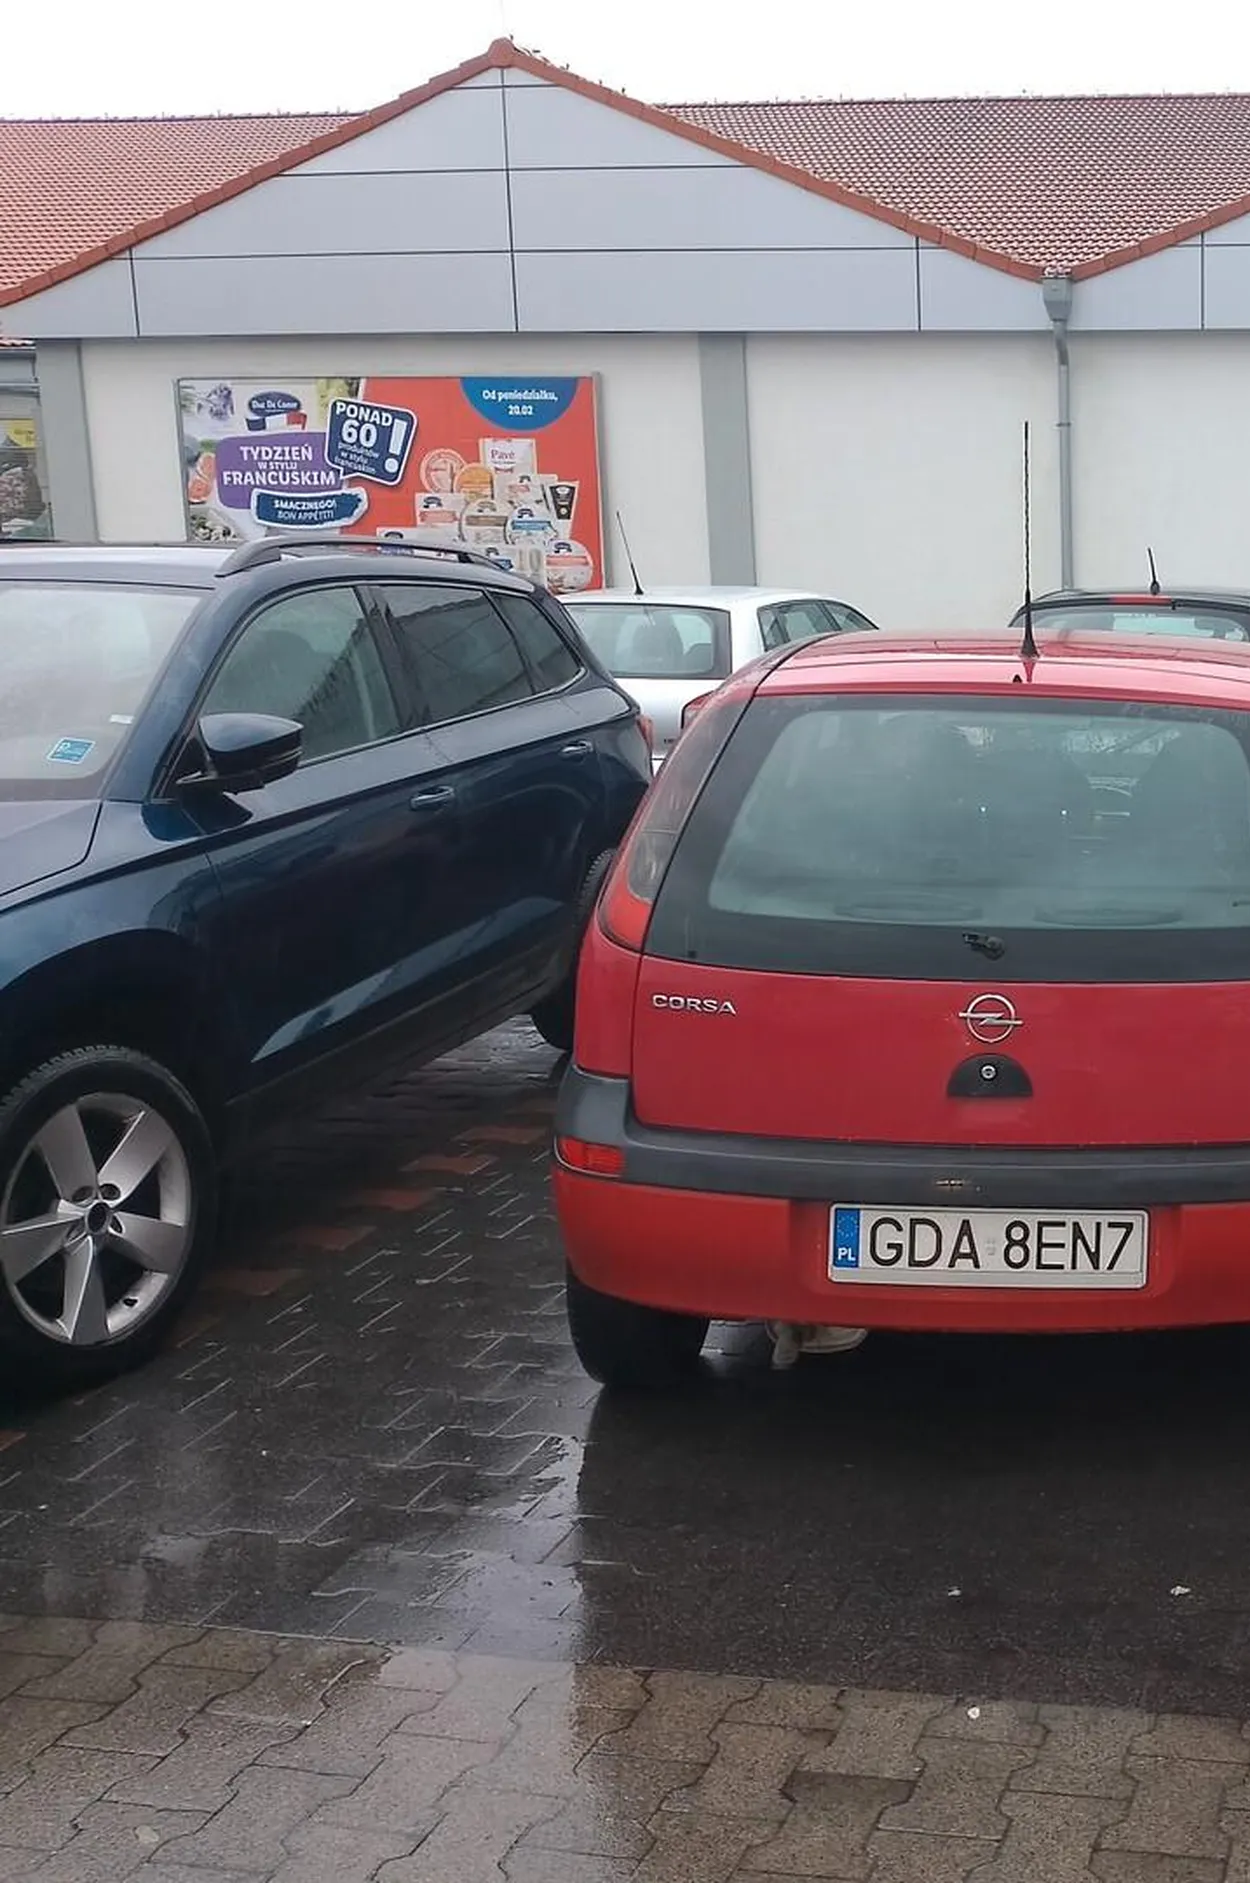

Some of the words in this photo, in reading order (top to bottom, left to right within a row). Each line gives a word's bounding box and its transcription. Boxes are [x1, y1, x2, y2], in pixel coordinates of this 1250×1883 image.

[482, 390, 496, 400] Od
[335, 401, 393, 427] PONAD
[507, 404, 533, 415] 20.02
[341, 419, 378, 448] 60
[240, 443, 313, 461] TYDZIEŃ
[257, 461, 268, 470] W
[269, 461, 298, 470] STYLU
[222, 470, 336, 486] FRANCUSKIM
[652, 994, 737, 1016] CORSA
[869, 1217, 981, 1269] GDA
[1003, 1219, 1134, 1270] 8EN7
[837, 1247, 856, 1262] PL
